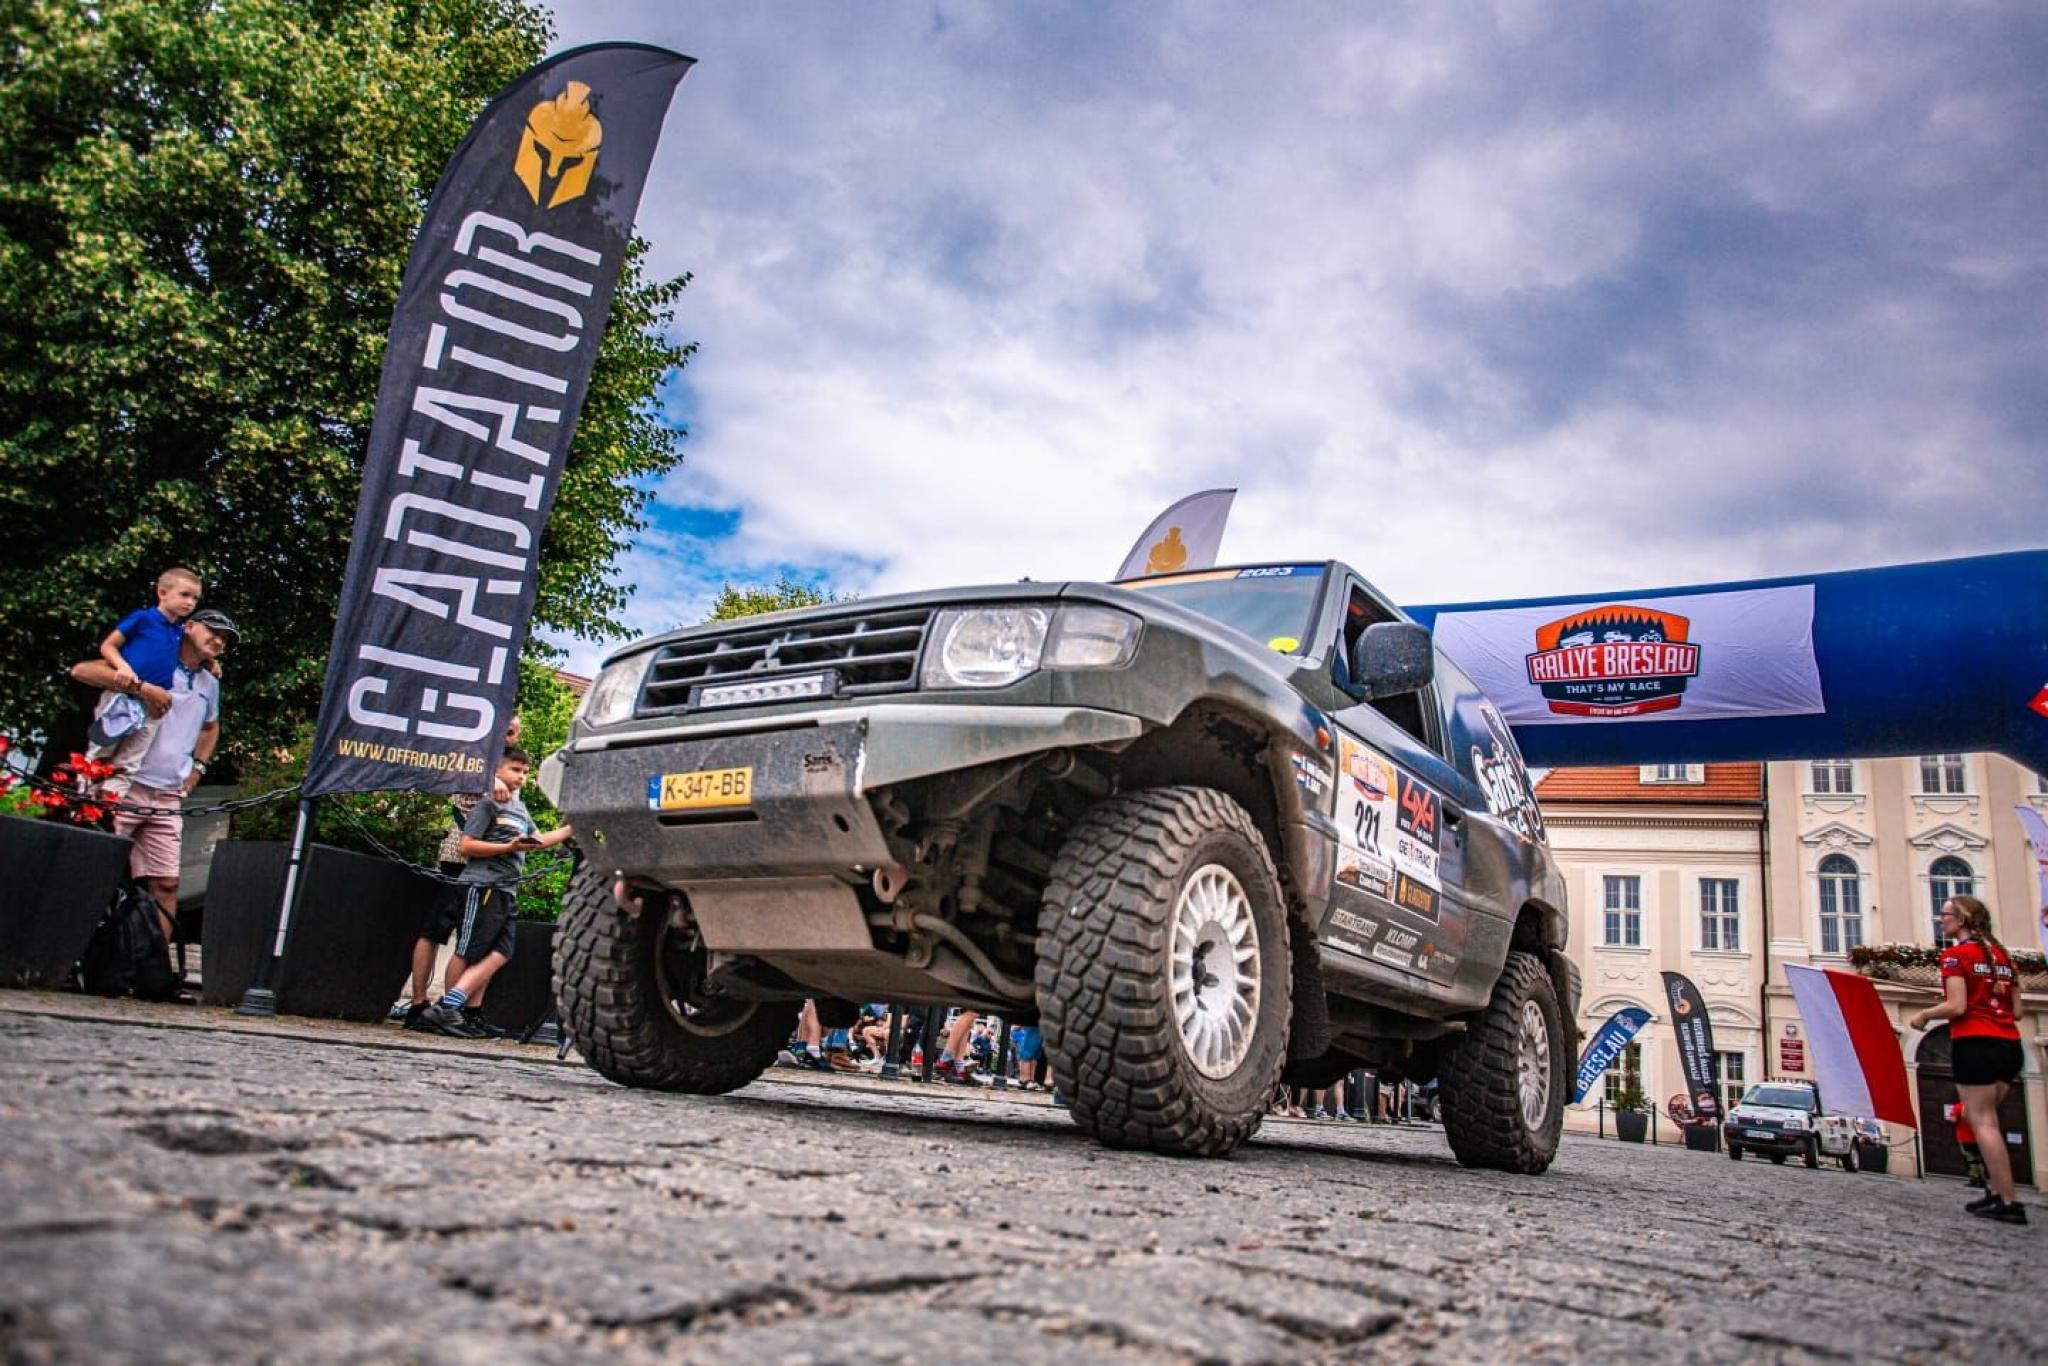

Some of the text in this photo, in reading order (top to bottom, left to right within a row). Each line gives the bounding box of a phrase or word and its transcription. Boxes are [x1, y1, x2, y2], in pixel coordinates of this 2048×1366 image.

[349, 209, 602, 744] GLADIATOR
[1532, 645, 1693, 680] RALLYE BRESLAU
[1565, 680, 1662, 695] THAT'S MY RACE
[338, 739, 486, 774] WWW.OFFROAD24.BG
[664, 771, 747, 801] K-347-BB
[1354, 799, 1382, 857] 221
[1576, 1029, 1629, 1092] BRESLAU
